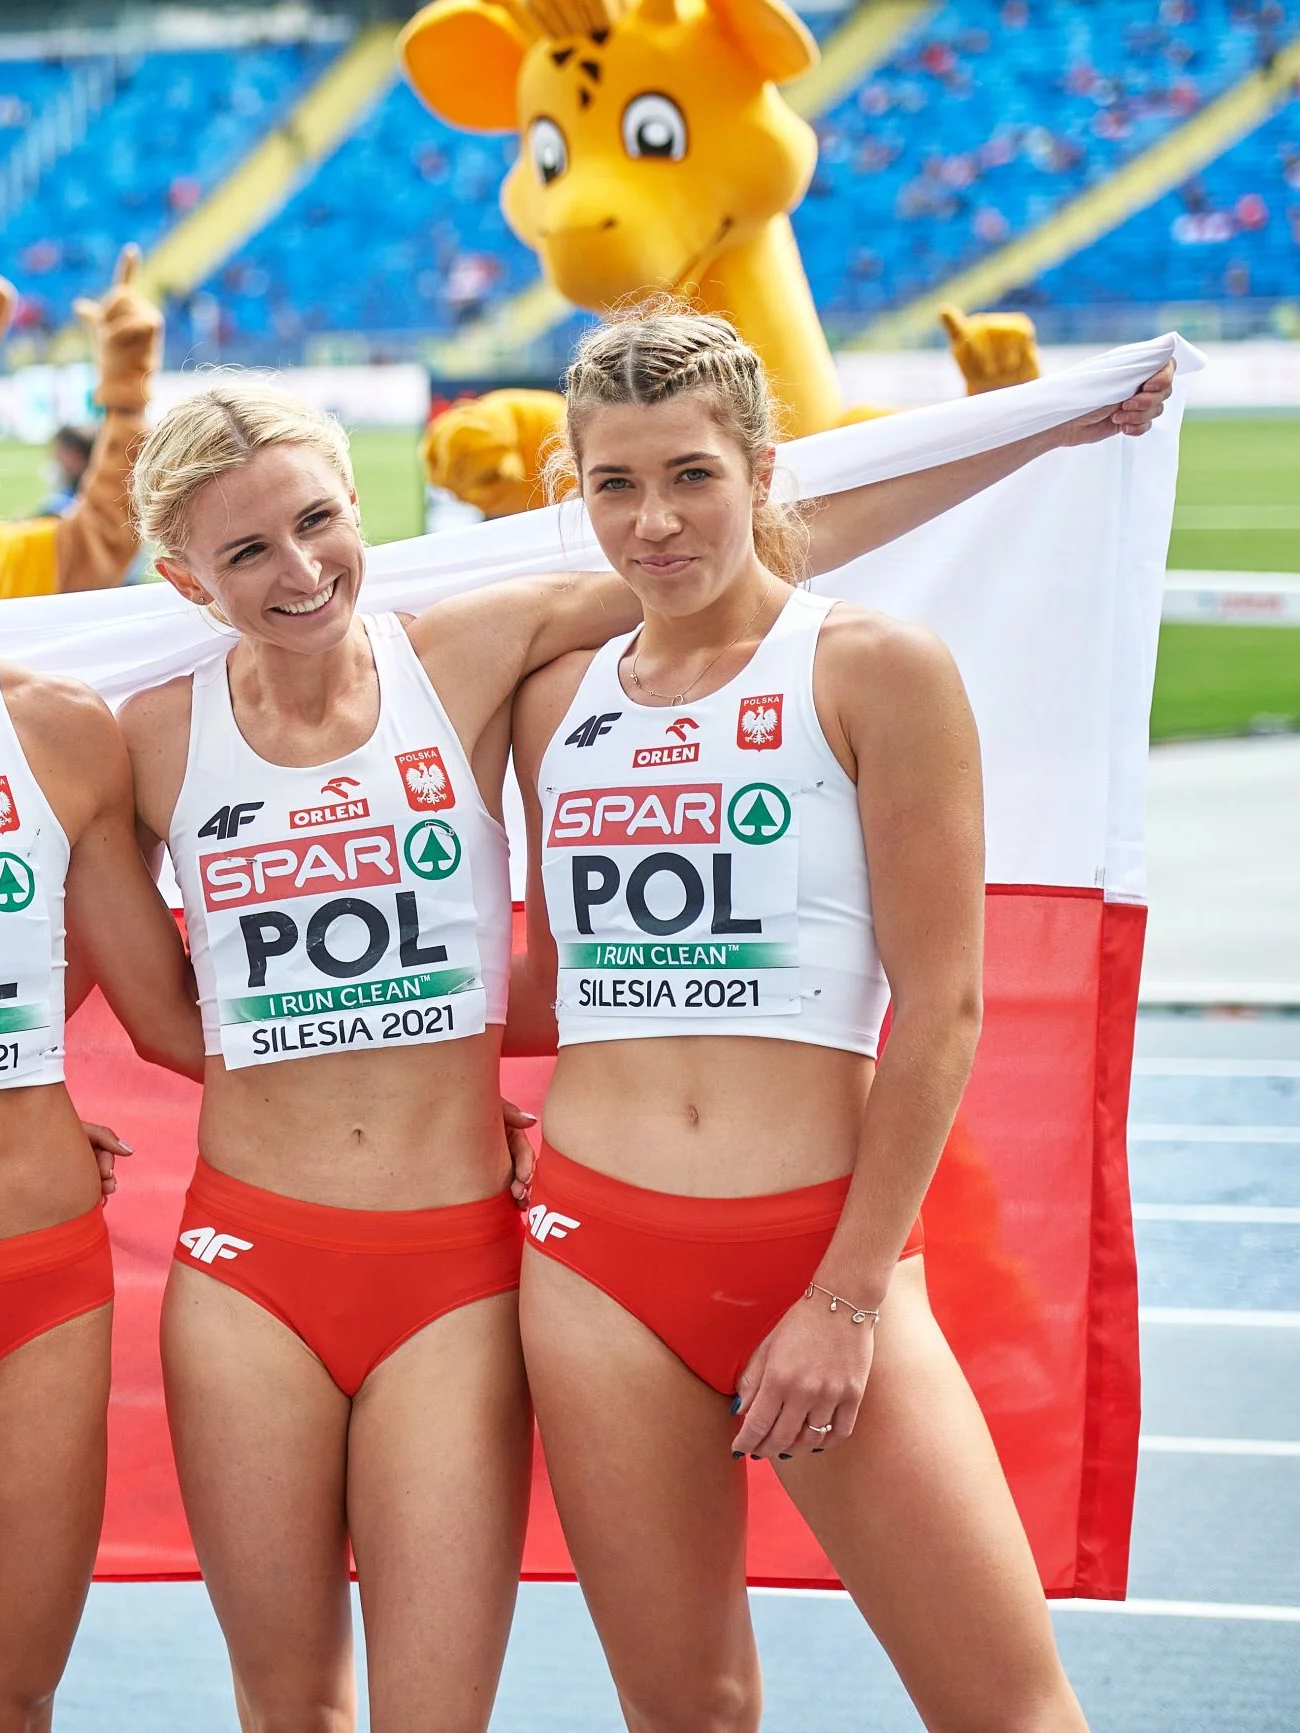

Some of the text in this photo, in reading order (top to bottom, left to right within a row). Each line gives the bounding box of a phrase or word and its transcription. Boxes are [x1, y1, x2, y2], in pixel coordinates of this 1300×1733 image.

[743, 696, 780, 706] POLSKA
[564, 712, 622, 748] 4F
[399, 750, 438, 762] POLSKA
[637, 746, 696, 765] ORLEN
[198, 801, 264, 839] 4F
[294, 802, 364, 826] ORLEN
[555, 793, 716, 839] SPAR
[206, 835, 394, 901] SPAR
[572, 852, 762, 936] POL
[239, 891, 448, 988] POL
[596, 947, 601, 964] I
[604, 946, 644, 965] RUN
[269, 998, 276, 1016] I
[281, 991, 334, 1014] RUN
[579, 979, 759, 1008] SILESIA 2021
[252, 1005, 454, 1054] SILESIA 2021
[528, 1204, 581, 1243] 4F
[179, 1226, 255, 1264] 4F
